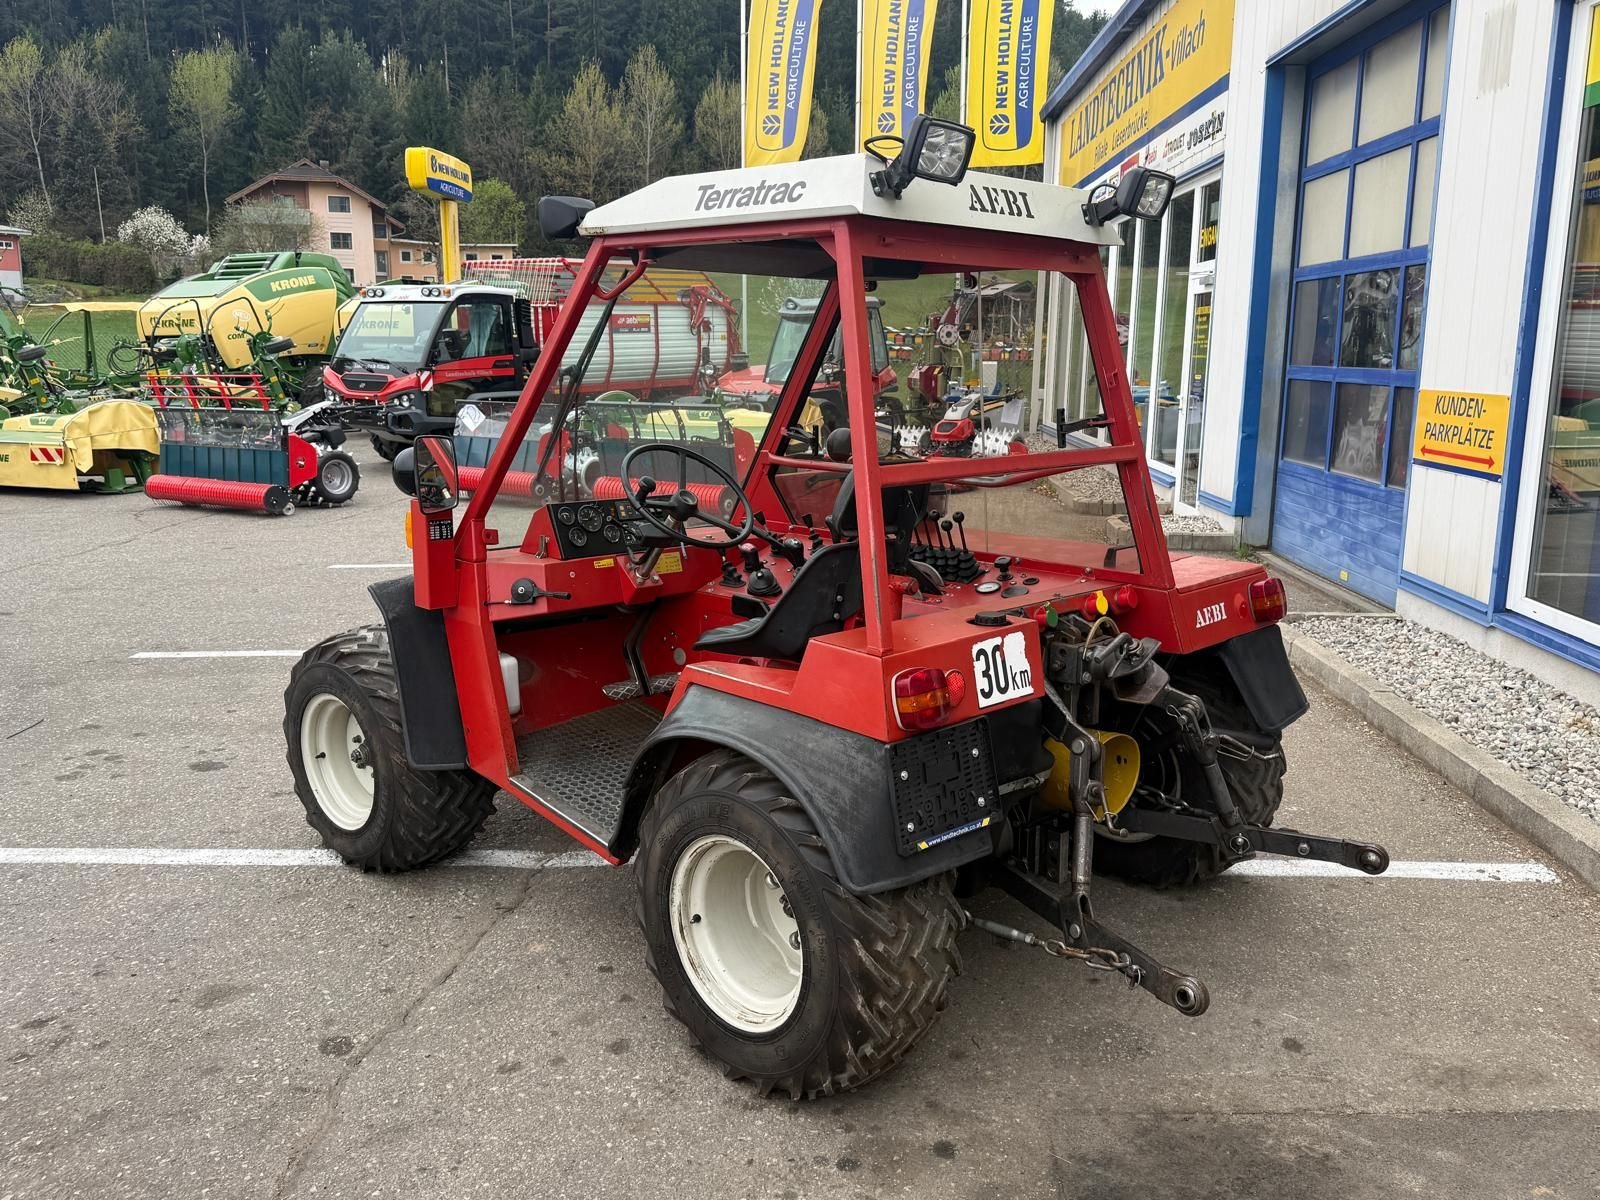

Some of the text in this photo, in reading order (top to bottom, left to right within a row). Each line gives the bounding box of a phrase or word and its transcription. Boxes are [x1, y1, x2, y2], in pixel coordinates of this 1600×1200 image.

[786, 20, 806, 110] AGRICULTURE
[904, 16, 919, 108] AGRICULTURE
[1018, 15, 1033, 109] AGRICULTURE
[767, 72, 780, 110] NEW
[883, 69, 896, 107] NEW
[996, 70, 1009, 109] NEW
[694, 180, 807, 212] Terratrac
[969, 184, 1035, 219] AEBI
[270, 275, 317, 293] KRONE
[161, 318, 196, 329] KRNE
[361, 320, 400, 329] KRONE
[1434, 395, 1486, 419] KUNDEN-
[1424, 421, 1495, 449] PARKPLÄTZE
[1195, 602, 1228, 628] AEBI
[928, 822, 982, 846] www.landtechnik.co.at
